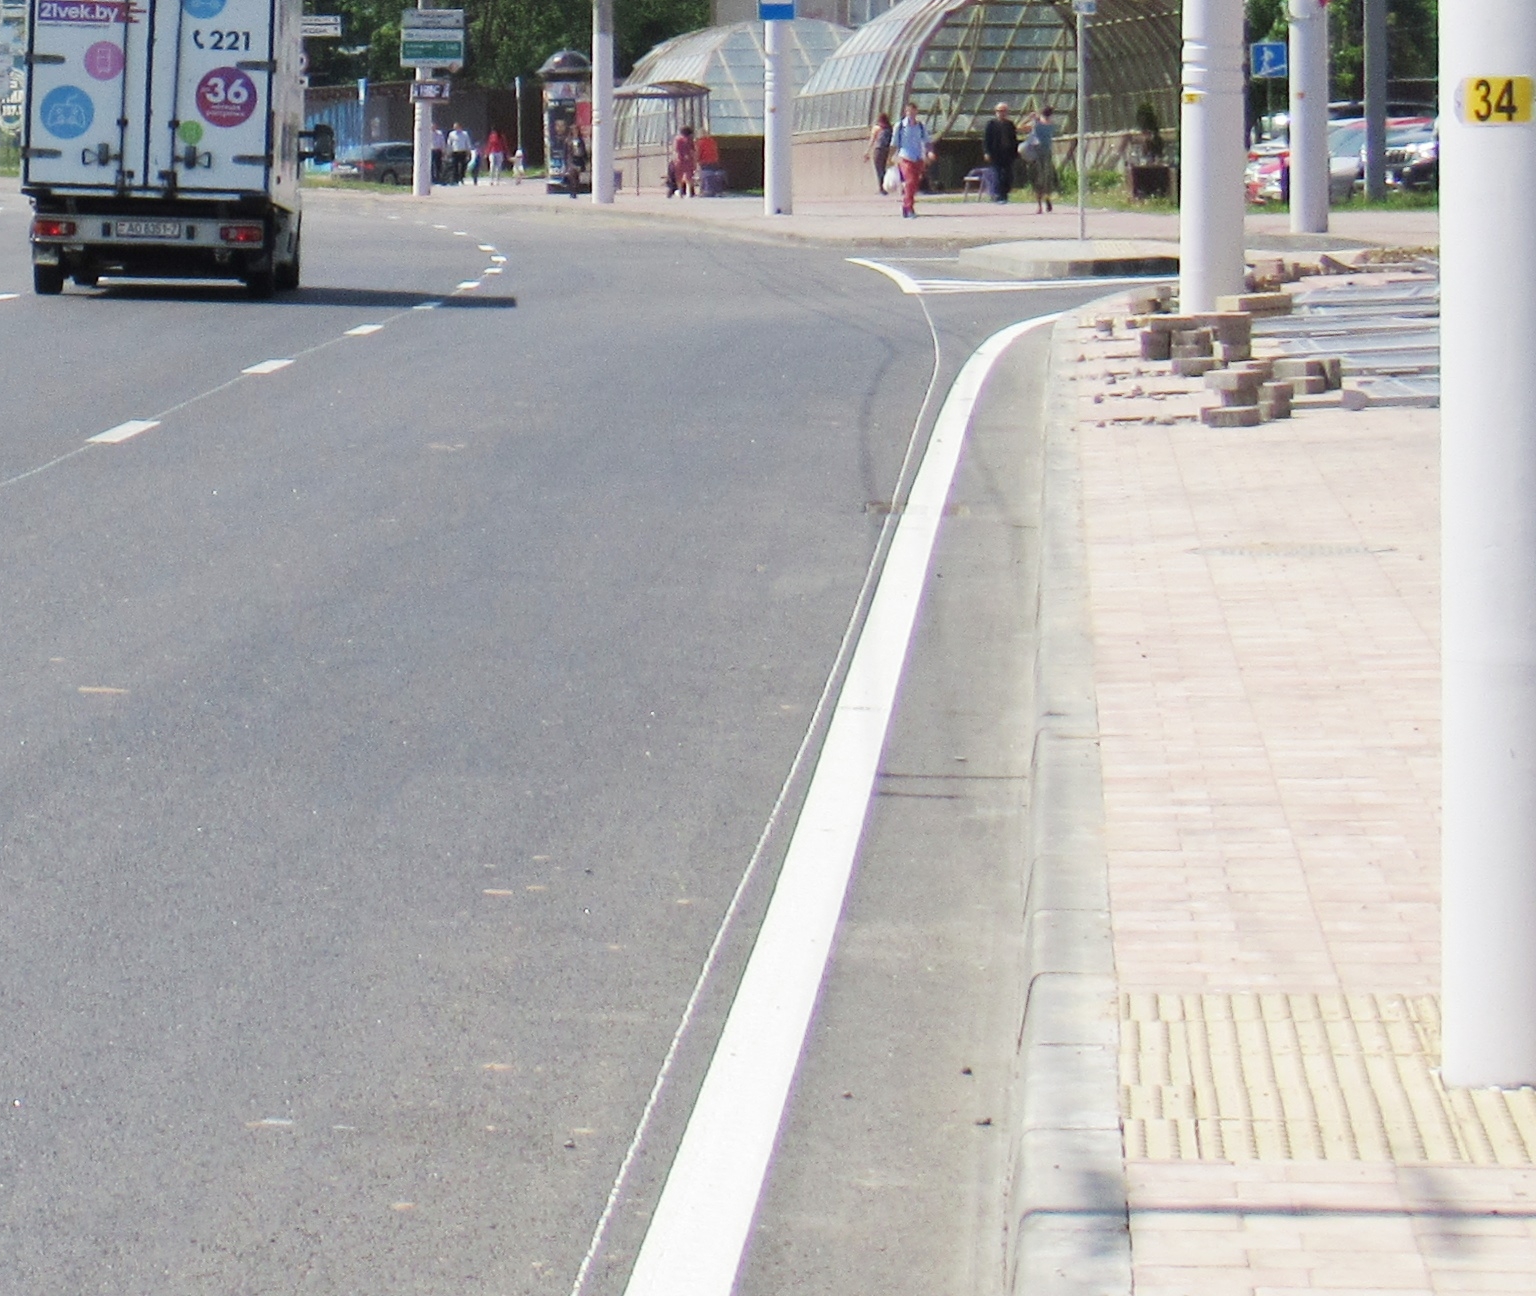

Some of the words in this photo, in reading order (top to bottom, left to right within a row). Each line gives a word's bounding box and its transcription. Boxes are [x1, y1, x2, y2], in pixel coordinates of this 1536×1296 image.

[40, 3, 118, 23] 21vek.by
[210, 30, 250, 51] 221
[206, 77, 248, 104] 36
[1474, 79, 1518, 122] 34
